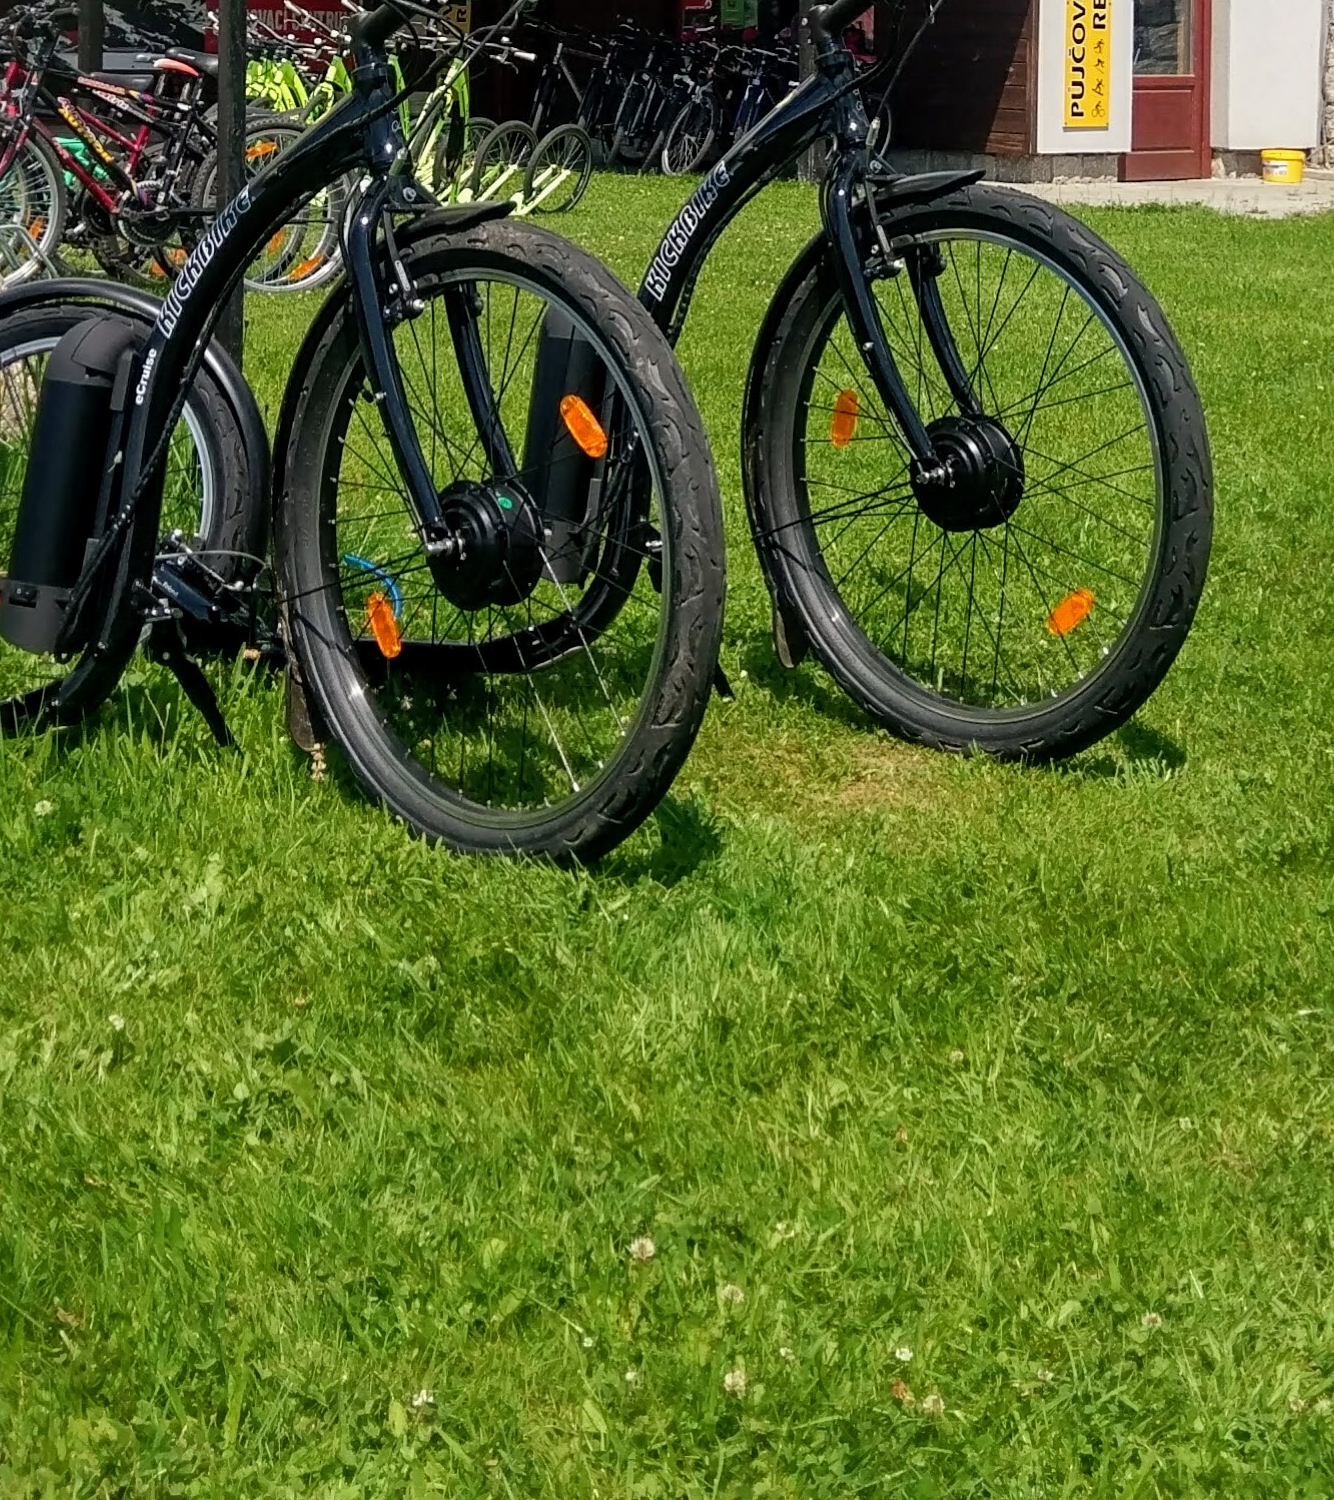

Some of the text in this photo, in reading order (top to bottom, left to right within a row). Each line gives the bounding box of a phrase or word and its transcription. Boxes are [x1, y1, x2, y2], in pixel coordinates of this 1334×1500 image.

[156, 185, 253, 340] KICKBIKE
[644, 160, 731, 302] KICKBIKE
[134, 347, 157, 406] eCruise
